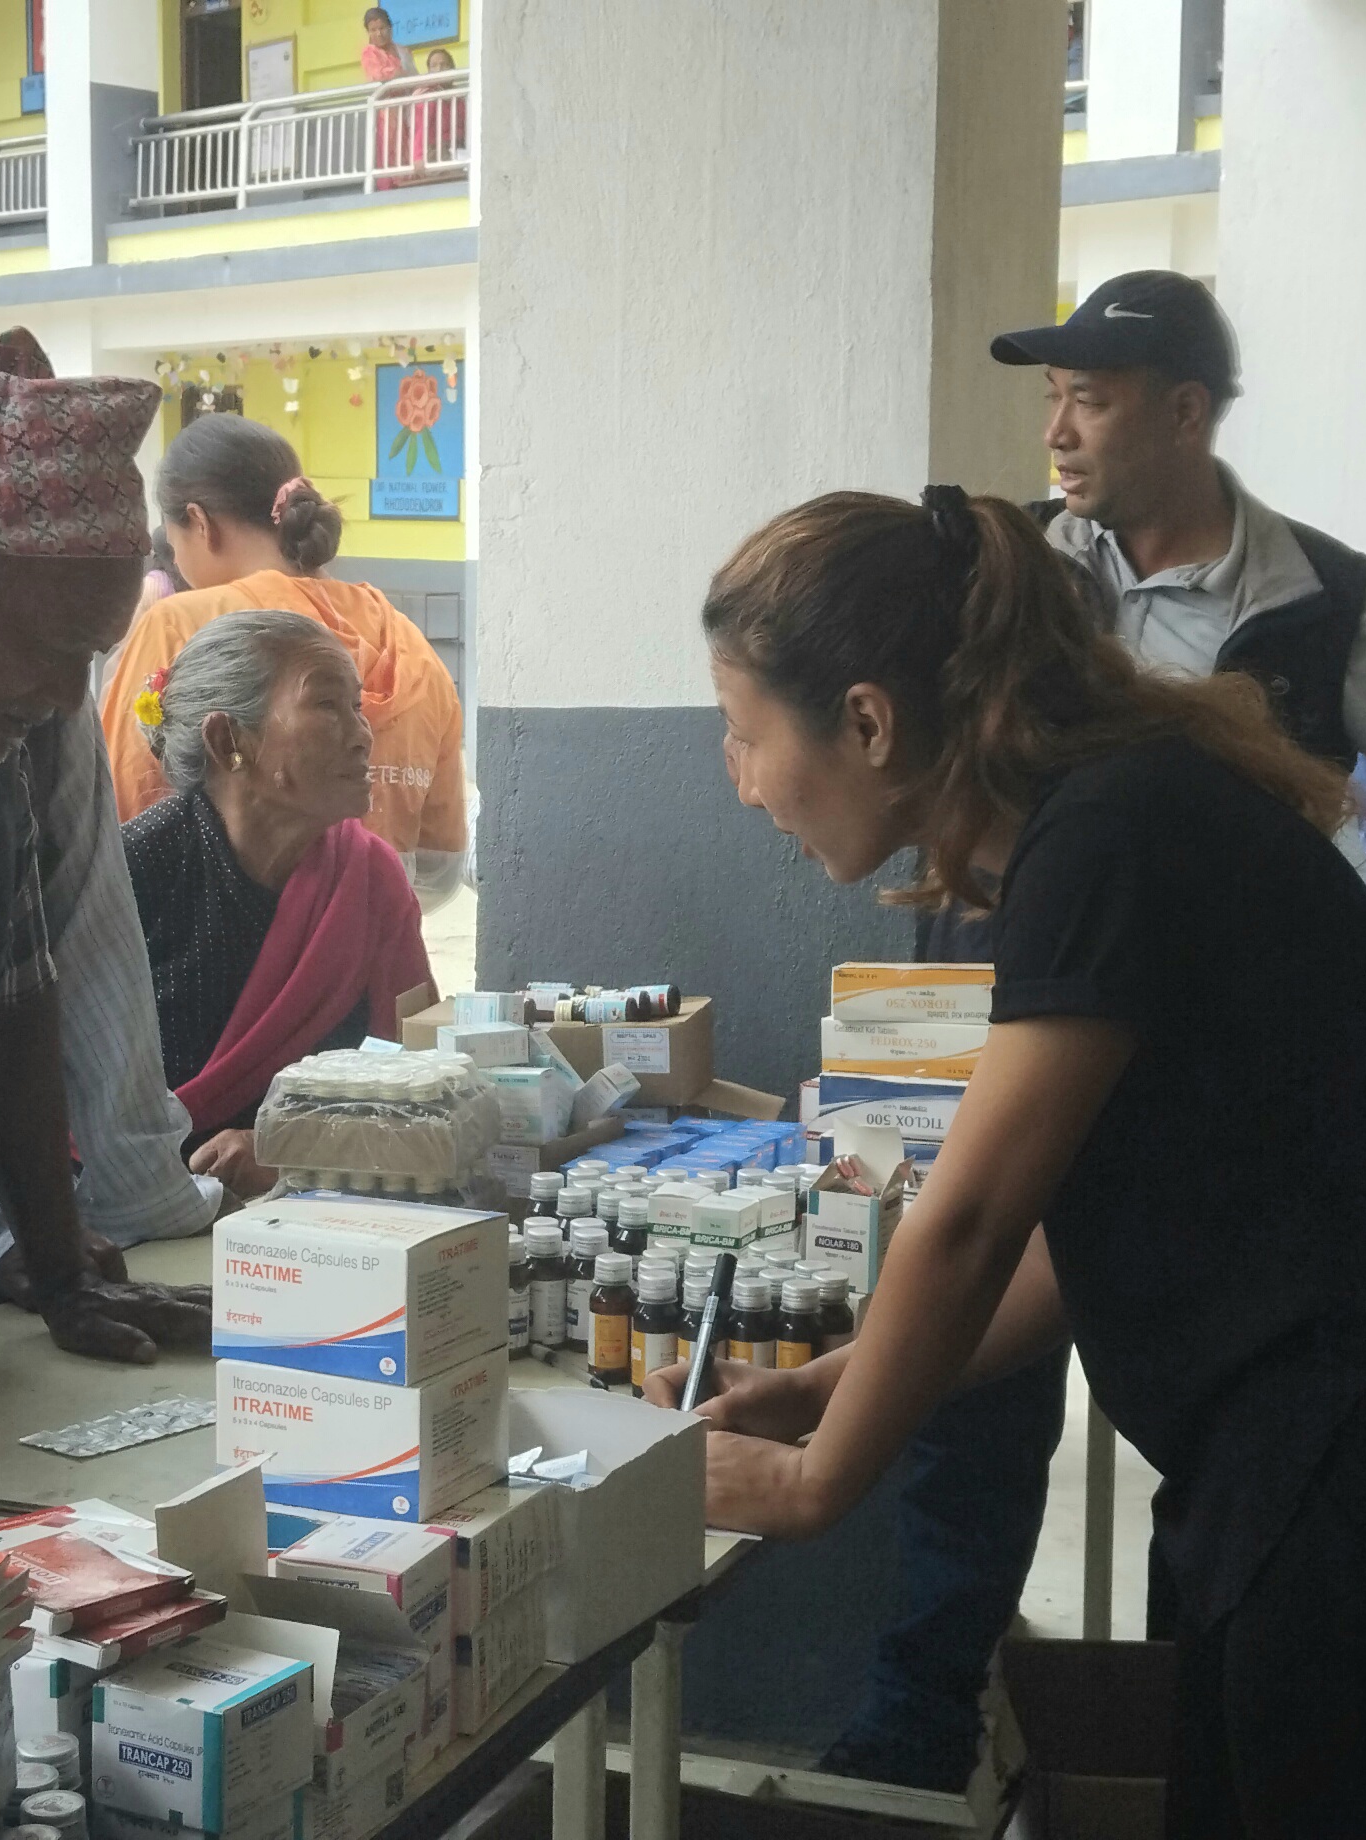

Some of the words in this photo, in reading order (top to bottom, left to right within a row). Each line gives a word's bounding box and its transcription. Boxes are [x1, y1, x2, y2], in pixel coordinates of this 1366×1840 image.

[392, 15, 451, 36] T-OF-ARMS
[388, 481, 417, 492] NATIONAL
[421, 481, 448, 493] FLOWER
[886, 998, 957, 1009] FEDROX-250
[870, 1036, 937, 1049] FEDROX-250
[866, 1113, 891, 1126] 500
[896, 1115, 944, 1130] TICLOX
[226, 1238, 298, 1261] Itraconazole
[301, 1248, 357, 1269] Capsules
[362, 1256, 380, 1271] BP
[437, 1238, 479, 1262] ITRATIME
[818, 1237, 859, 1251] NOLAR-180
[226, 1259, 302, 1284] ITRATIME
[250, 1282, 277, 1294] Capsules
[233, 1376, 308, 1399] Itraconazole
[311, 1386, 370, 1409] Capsules
[374, 1396, 392, 1411] BP
[233, 1396, 313, 1422] ITRATIME
[259, 1420, 287, 1431] Capsules
[243, 1693, 278, 1723] TRANCAP
[281, 1684, 297, 1705] 250
[108, 1723, 146, 1743] Tranexamic
[148, 1732, 163, 1746] Acid
[164, 1737, 195, 1755] Capsules
[122, 1746, 170, 1771] TRANCAP
[171, 1761, 191, 1776] 250
